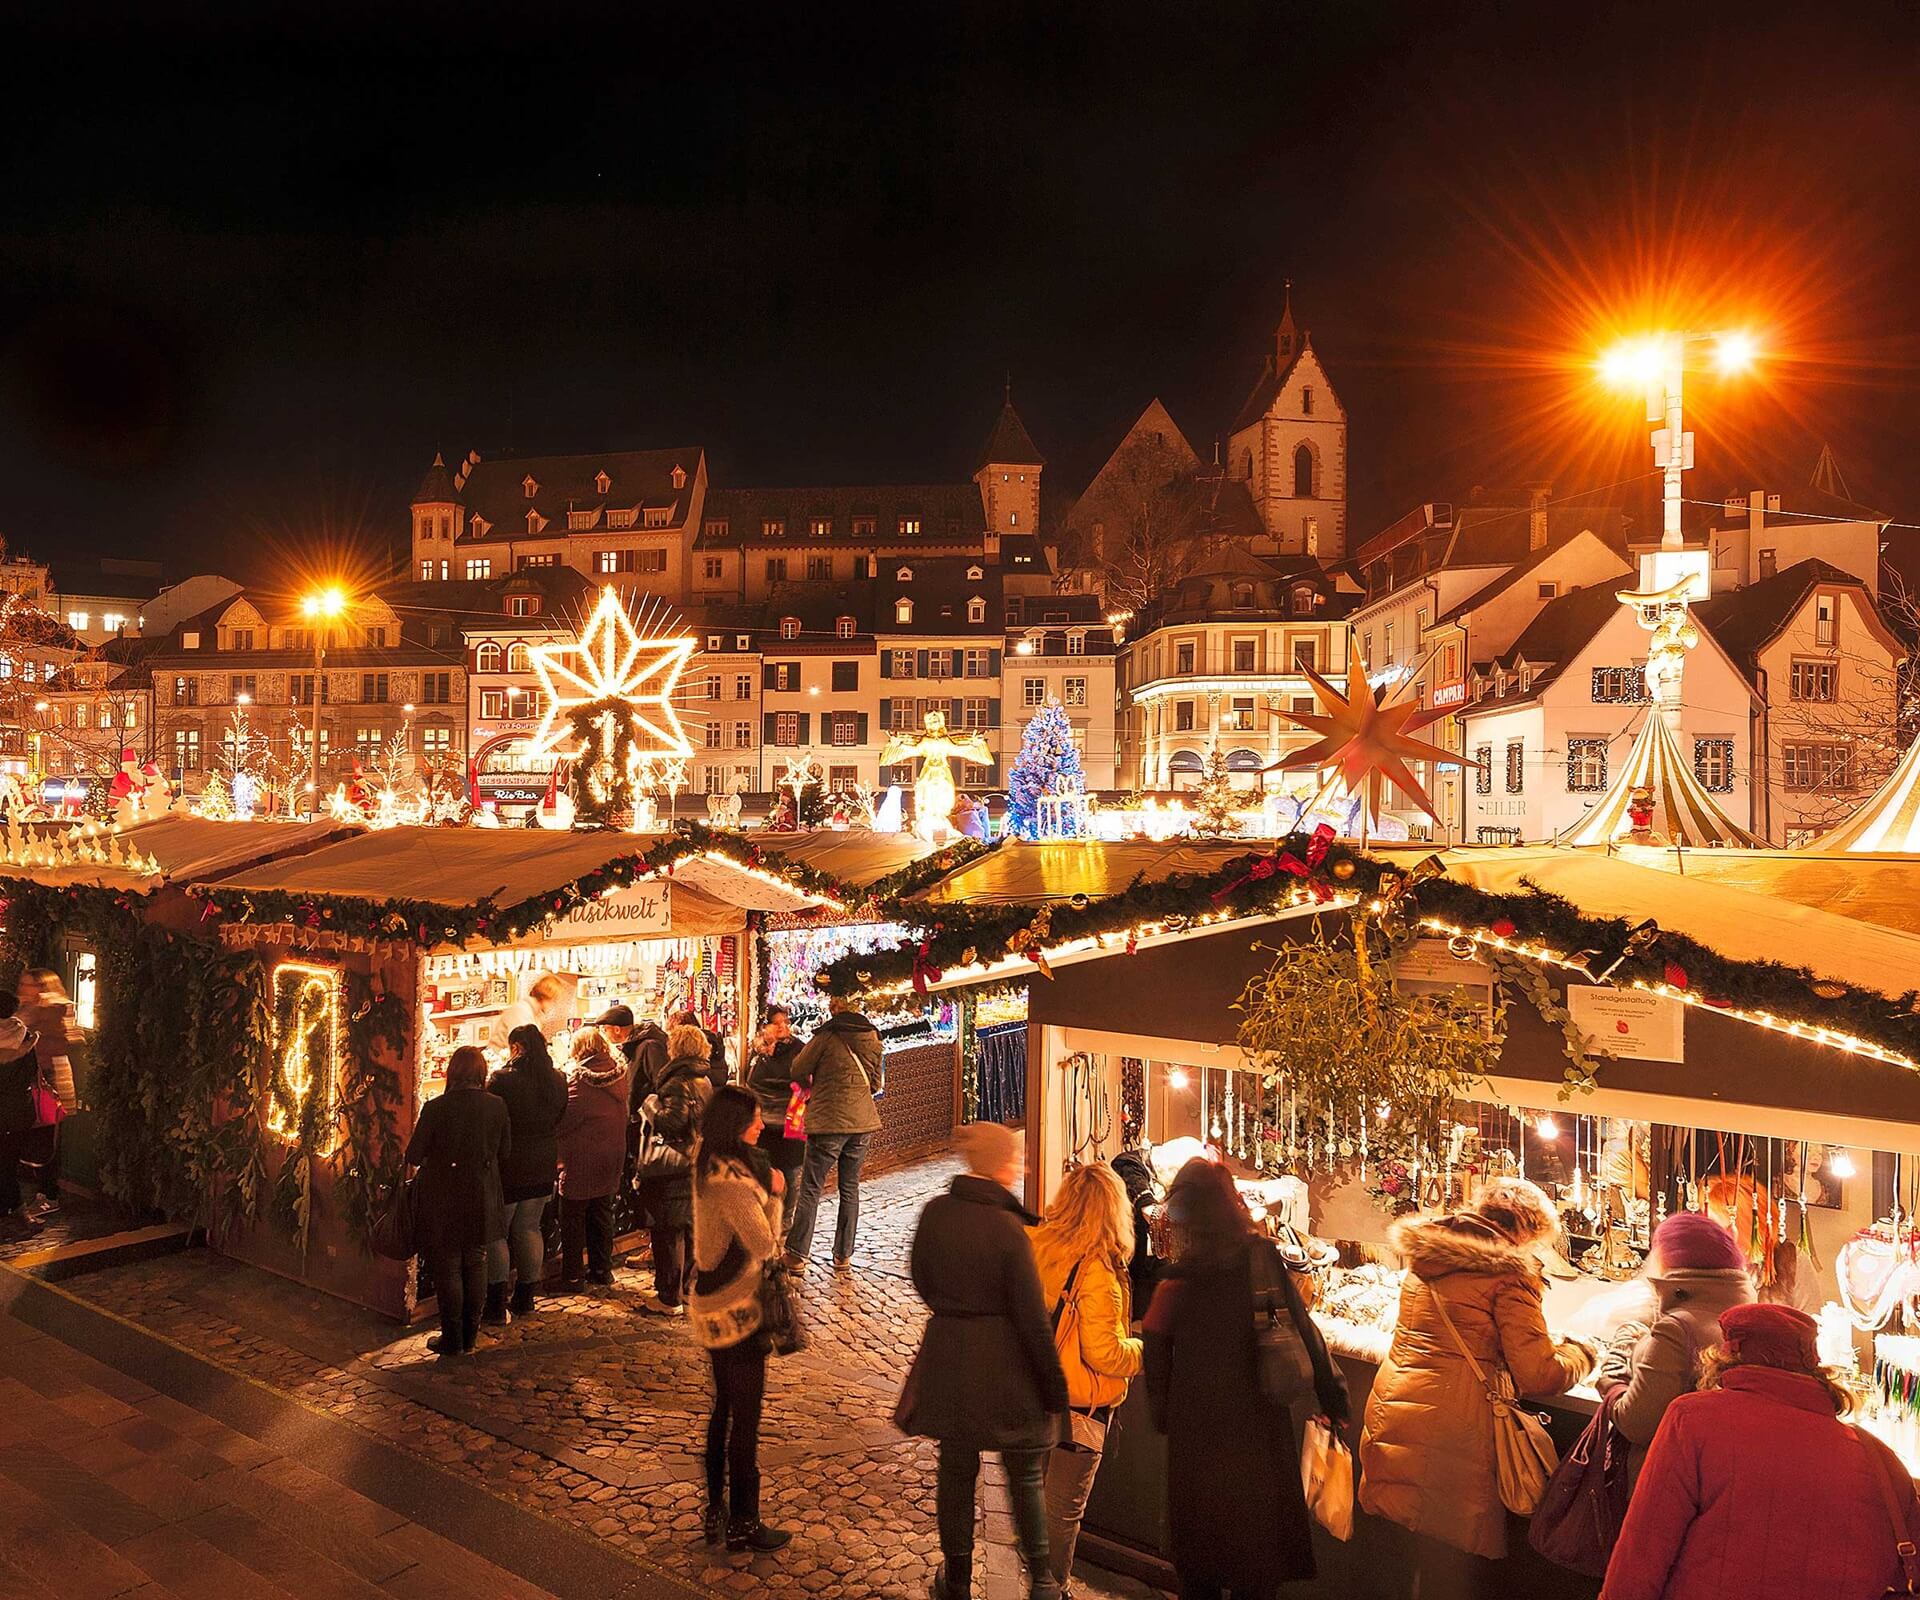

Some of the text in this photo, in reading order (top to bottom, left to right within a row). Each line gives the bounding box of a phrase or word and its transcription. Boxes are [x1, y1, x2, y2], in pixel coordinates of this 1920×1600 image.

[1433, 683, 1465, 706] CAMPARI
[1477, 801, 1526, 816] SEILER
[1590, 993, 1657, 1006] Standgestaltung
